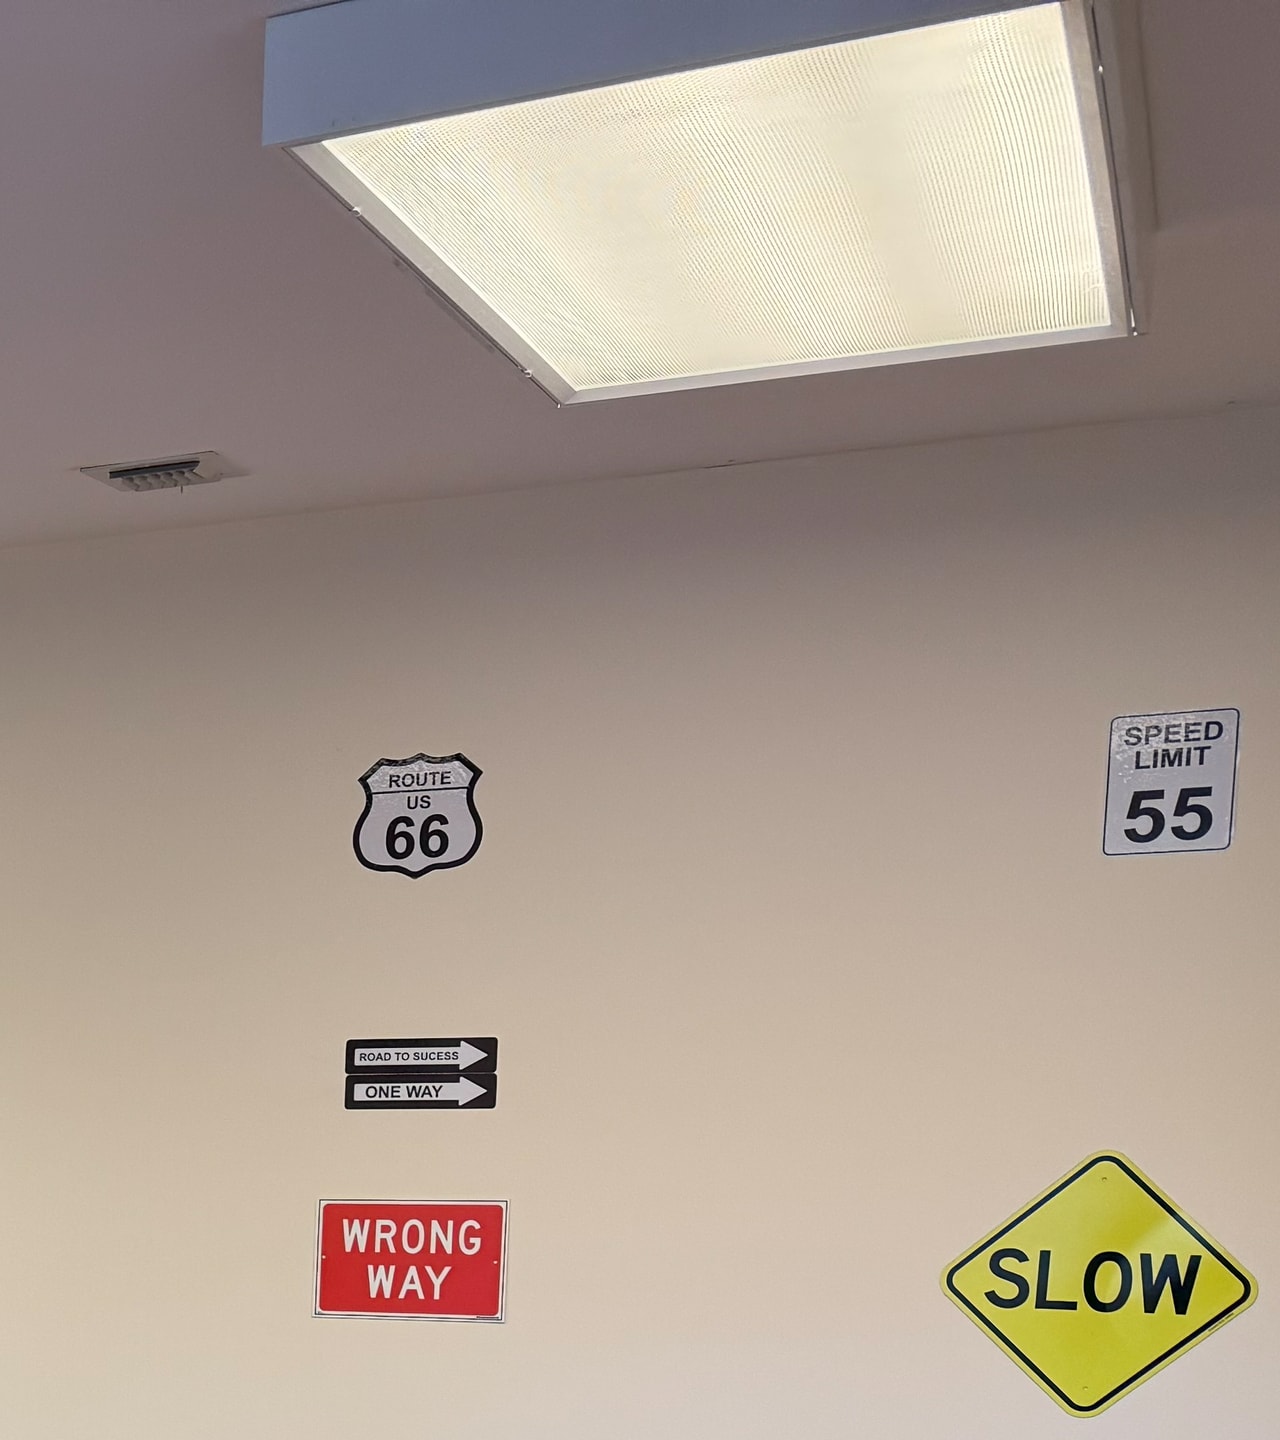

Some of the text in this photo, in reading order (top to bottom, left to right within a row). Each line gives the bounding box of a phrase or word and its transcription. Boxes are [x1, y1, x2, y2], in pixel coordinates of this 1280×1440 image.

[1124, 720, 1224, 747] SPEED
[1135, 745, 1211, 770] LIMIT
[388, 771, 452, 788] ROUTE
[406, 795, 431, 810] US
[1124, 786, 1213, 843] 55
[385, 813, 449, 860] 66
[359, 1051, 459, 1061] ROAD TO SUCESS
[365, 1085, 443, 1099] ONE WAY
[342, 1218, 482, 1255] WRONG
[367, 1264, 452, 1300] WAY
[984, 1247, 1202, 1316] SLOW
